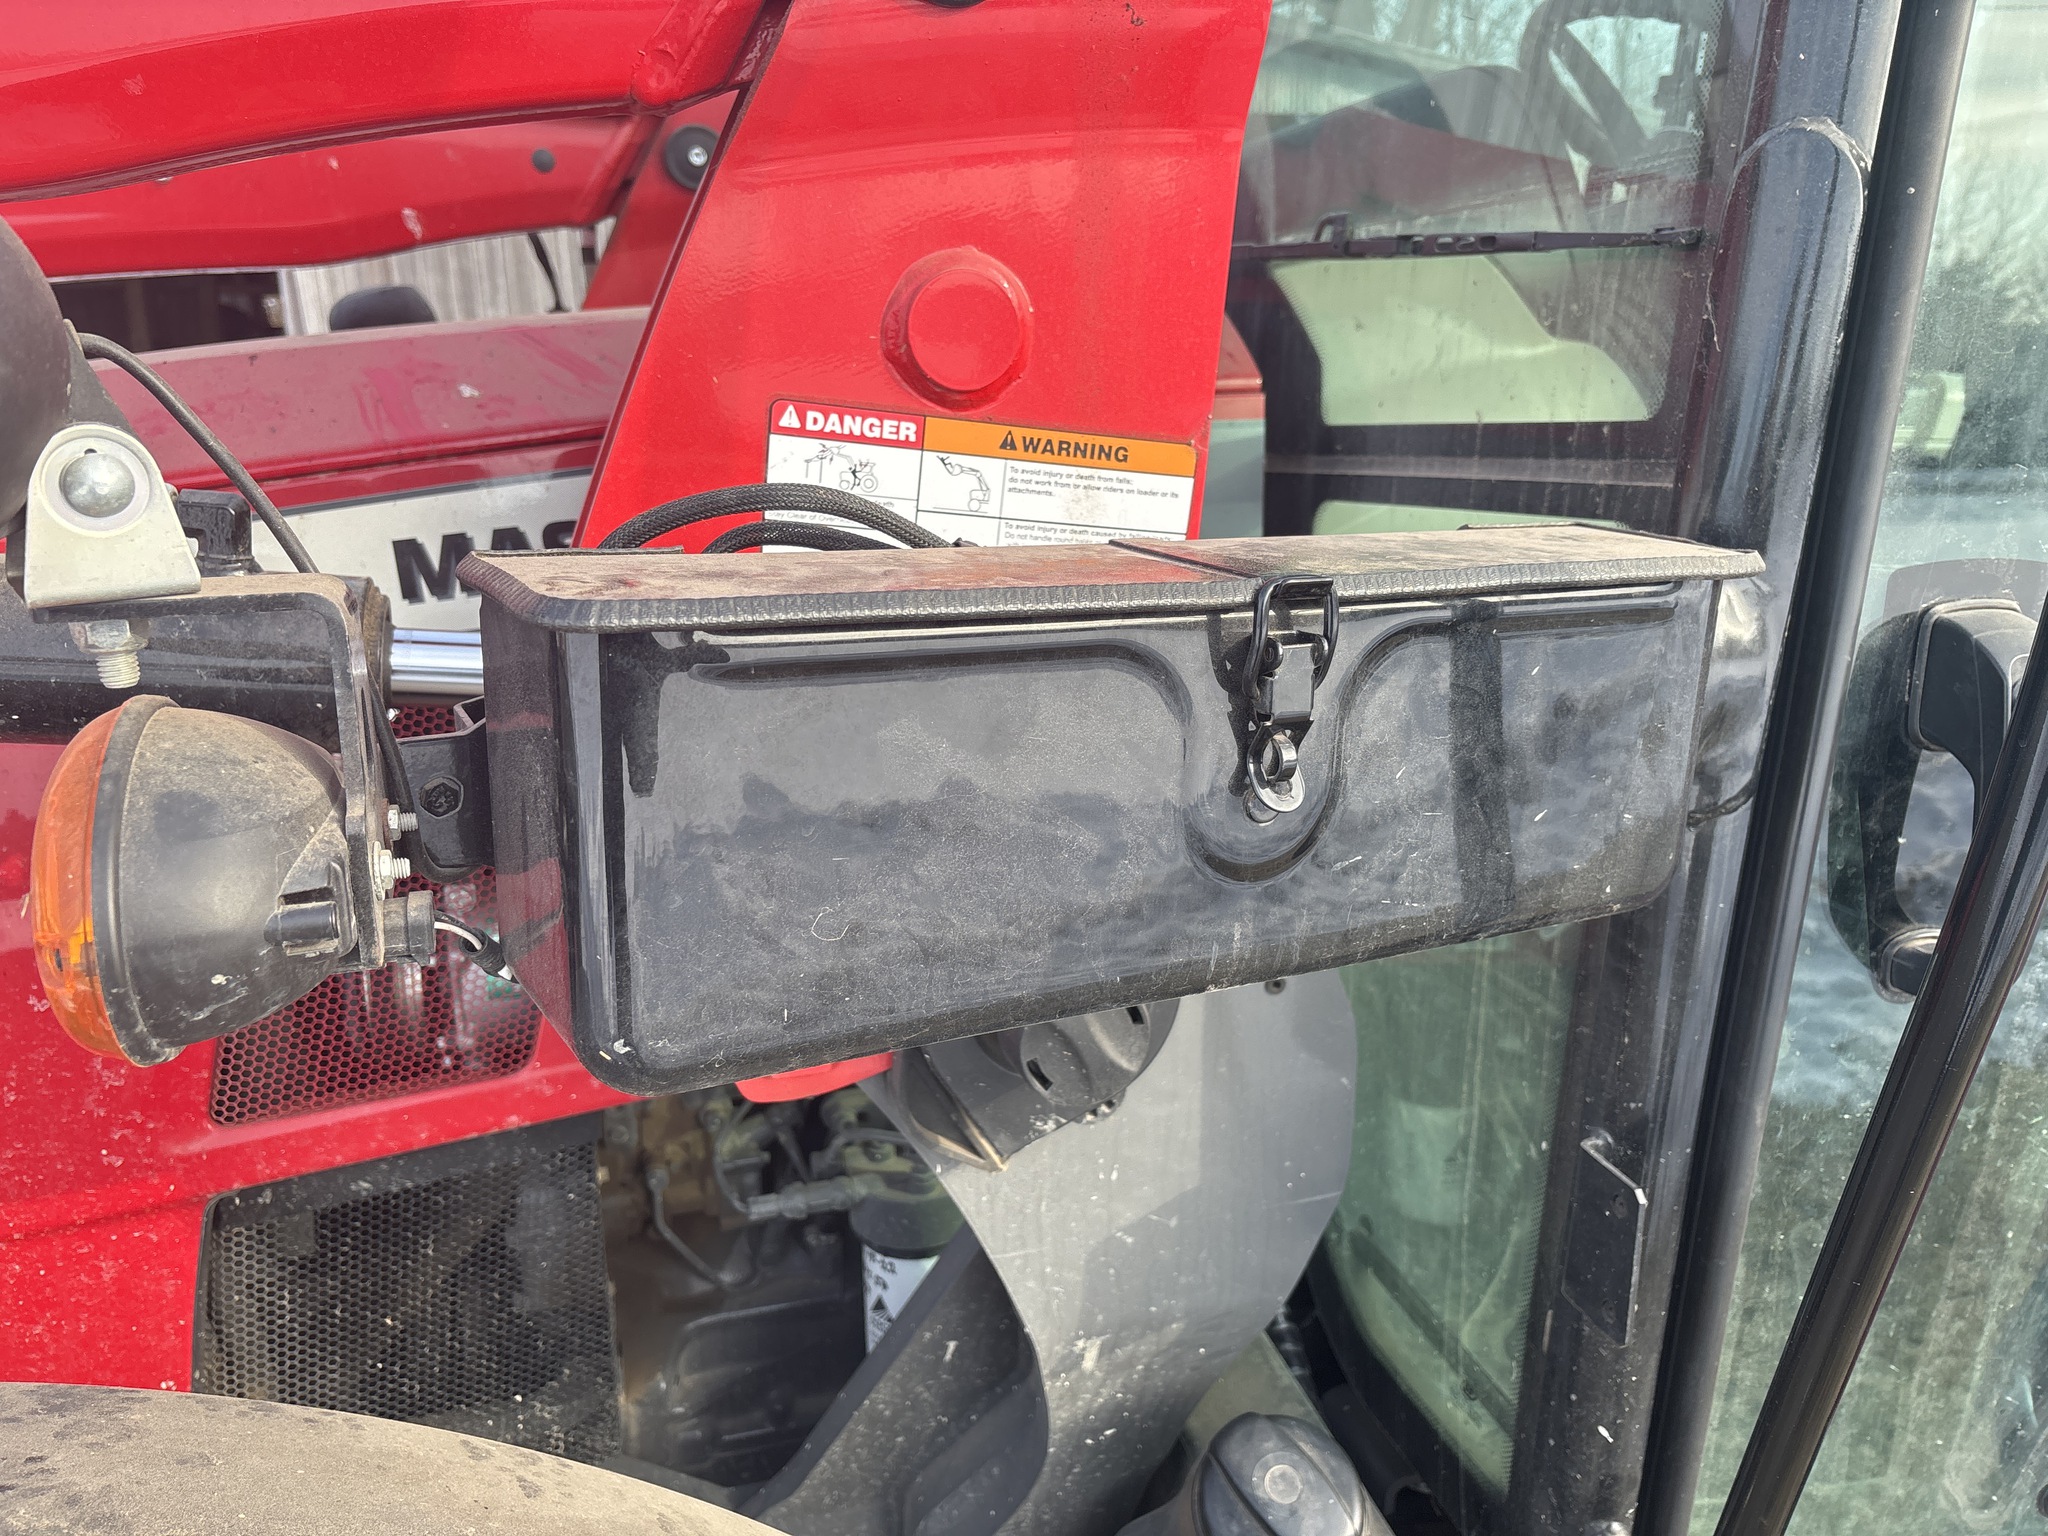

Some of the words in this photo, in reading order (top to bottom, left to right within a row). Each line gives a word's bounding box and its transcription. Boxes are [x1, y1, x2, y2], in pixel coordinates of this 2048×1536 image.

[805, 410, 917, 442] DANGER
[1021, 436, 1129, 463] WARNING
[1010, 466, 1019, 474] To
[1020, 468, 1041, 476] avoid
[1043, 470, 1063, 479] injury
[1075, 473, 1096, 481] death
[1054, 481, 1072, 489] from
[1082, 484, 1102, 492] allow
[1102, 486, 1124, 494] riders
[1137, 488, 1160, 497] loader
[1015, 523, 1036, 531] avoid
[1037, 525, 1058, 534] injury
[1029, 534, 1053, 542] handle
